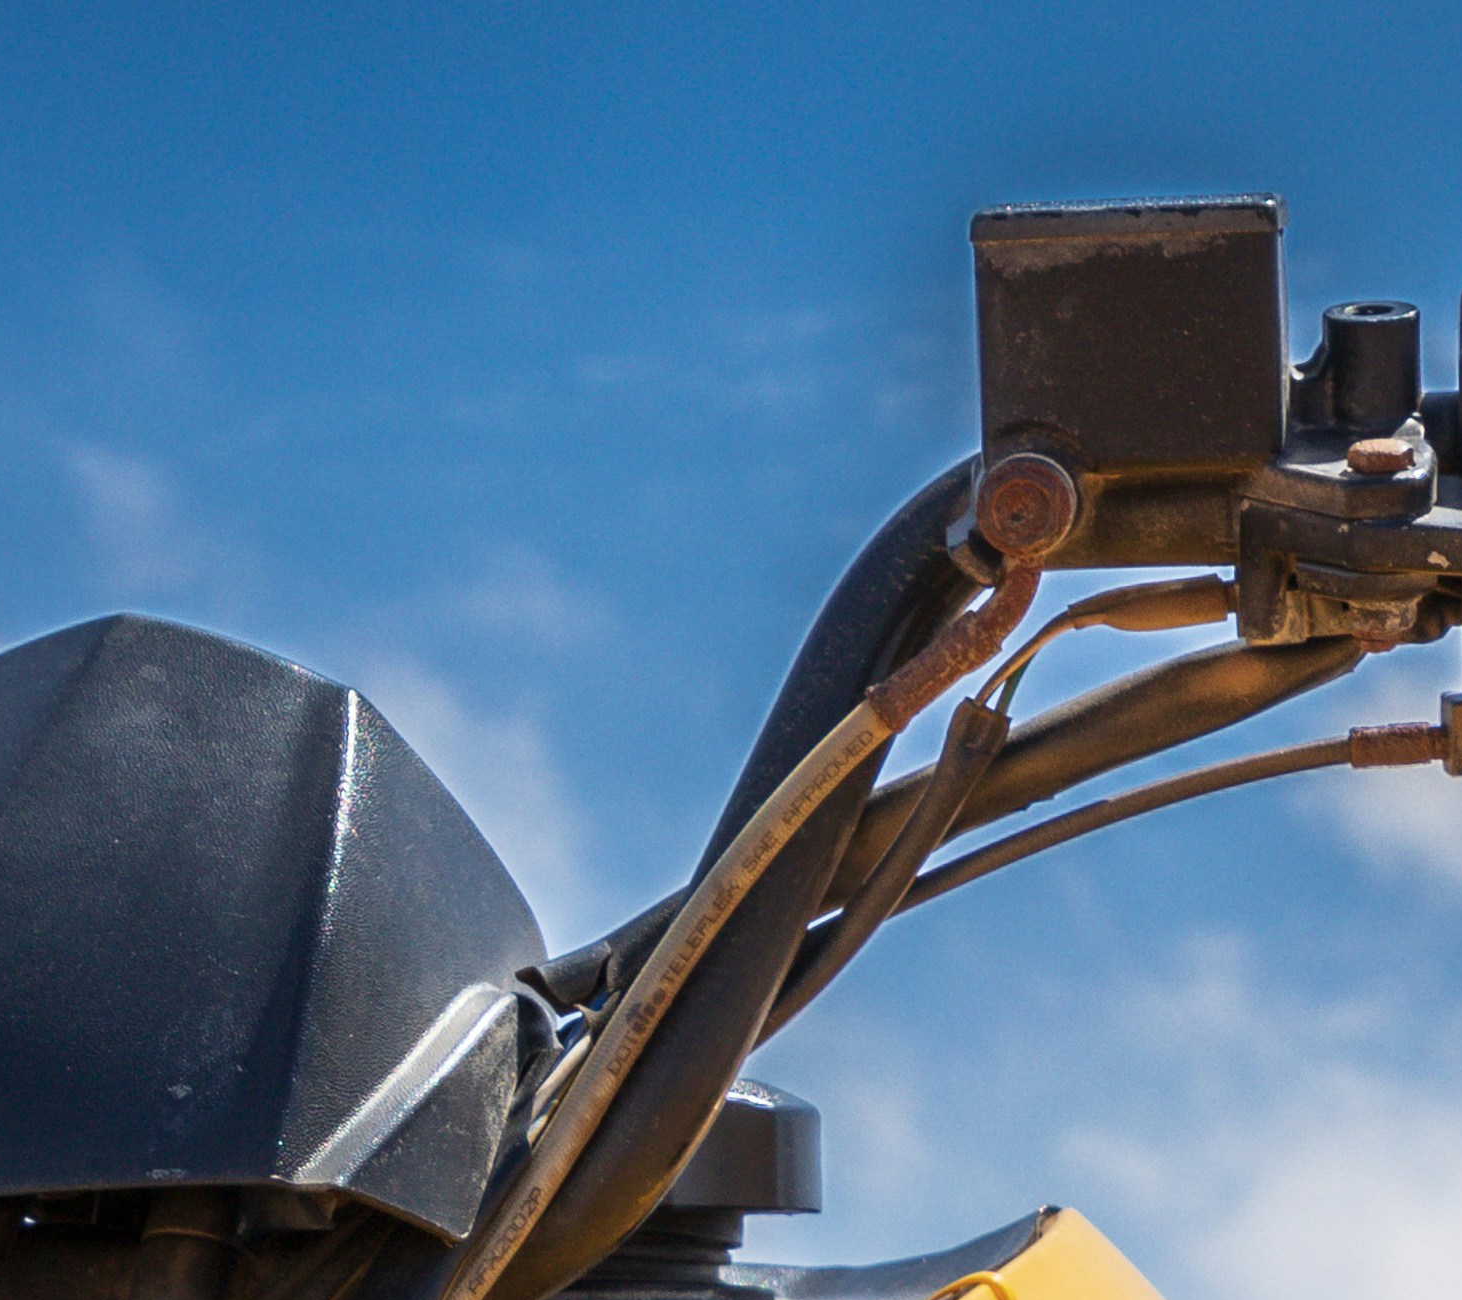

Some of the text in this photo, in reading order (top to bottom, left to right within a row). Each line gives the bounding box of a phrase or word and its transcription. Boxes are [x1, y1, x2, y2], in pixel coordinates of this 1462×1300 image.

[664, 876, 742, 992] TELEFLEX
[742, 830, 781, 873] SAE
[782, 730, 874, 826] APPROVED
